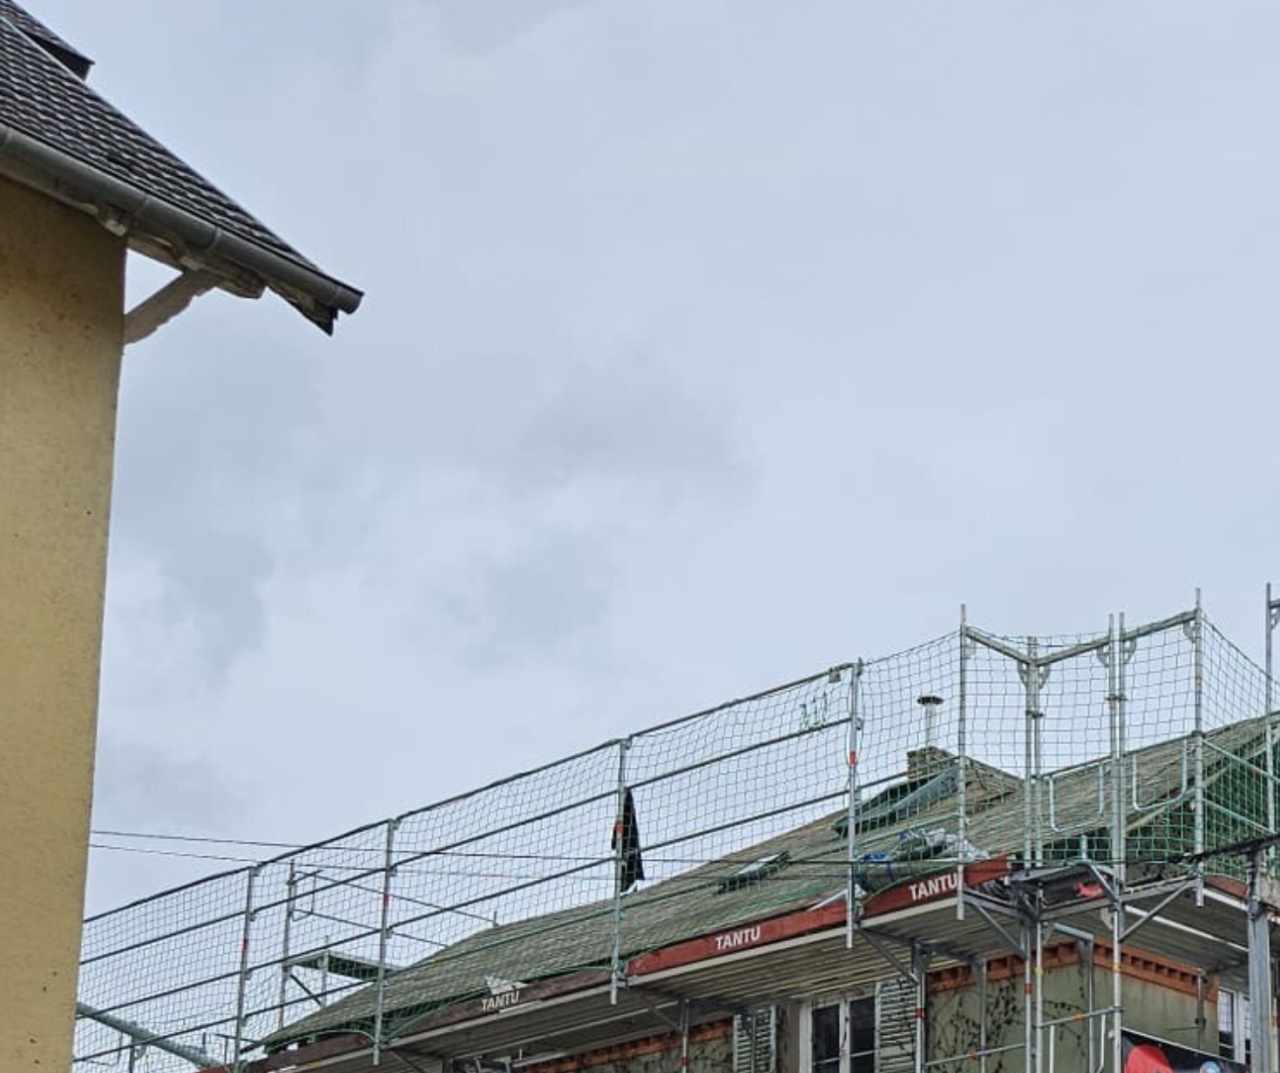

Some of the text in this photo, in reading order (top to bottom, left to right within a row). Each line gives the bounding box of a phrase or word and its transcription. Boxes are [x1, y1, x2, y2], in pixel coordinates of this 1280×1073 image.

[909, 872, 958, 901] TANTU
[716, 926, 761, 951] TANTU
[482, 991, 520, 1012] TANTU
